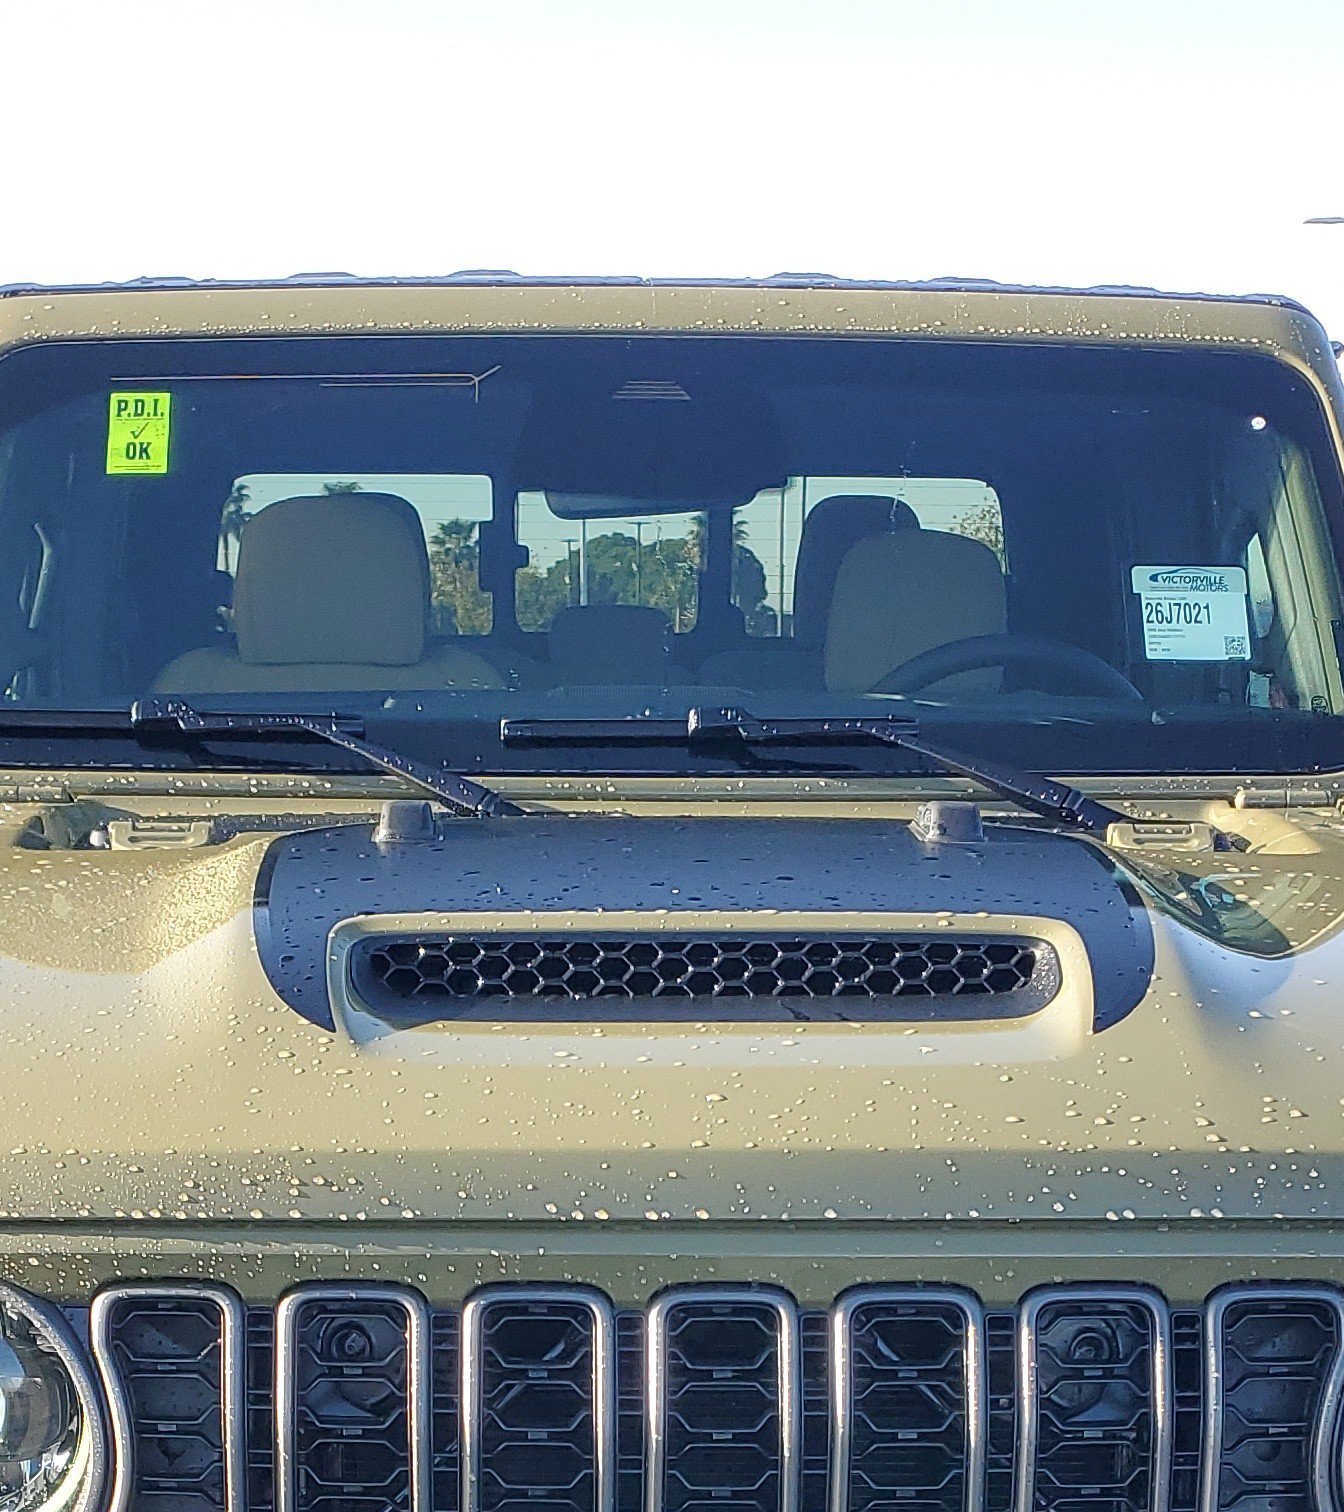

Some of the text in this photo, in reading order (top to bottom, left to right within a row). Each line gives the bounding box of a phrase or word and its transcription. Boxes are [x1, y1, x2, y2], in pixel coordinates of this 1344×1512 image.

[116, 399, 164, 417] P.D.I.
[125, 441, 152, 460] OK
[1161, 575, 1225, 584] VICTORVILLE
[1189, 584, 1229, 592] MOTORS
[1145, 602, 1211, 624] 26J7021
